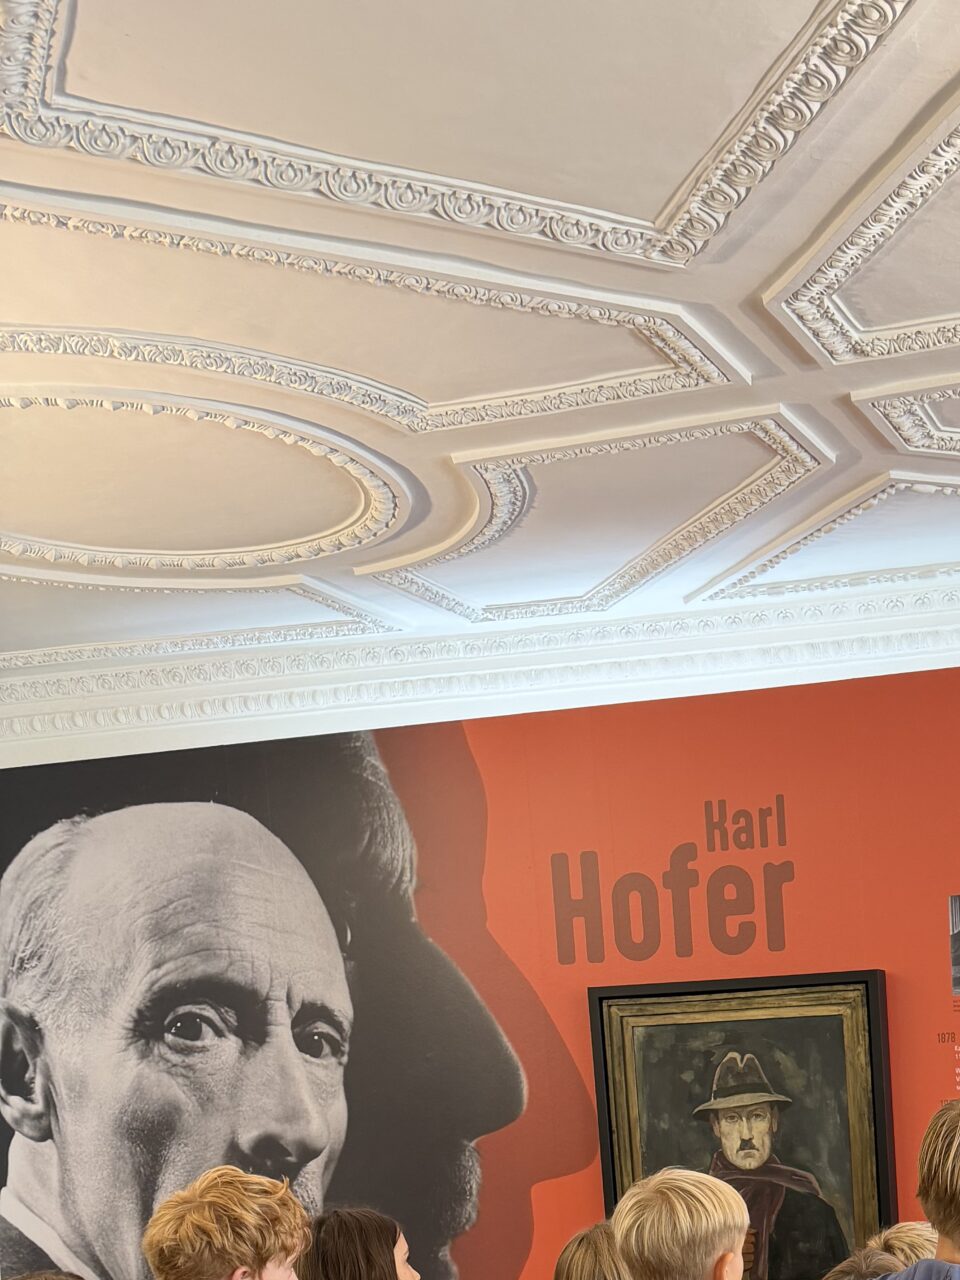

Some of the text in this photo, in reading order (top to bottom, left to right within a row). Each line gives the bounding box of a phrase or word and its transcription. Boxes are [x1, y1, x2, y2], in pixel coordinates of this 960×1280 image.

[704, 794, 787, 852] Karl
[550, 842, 795, 965] Hofer
[938, 1032, 956, 1043] 1878
